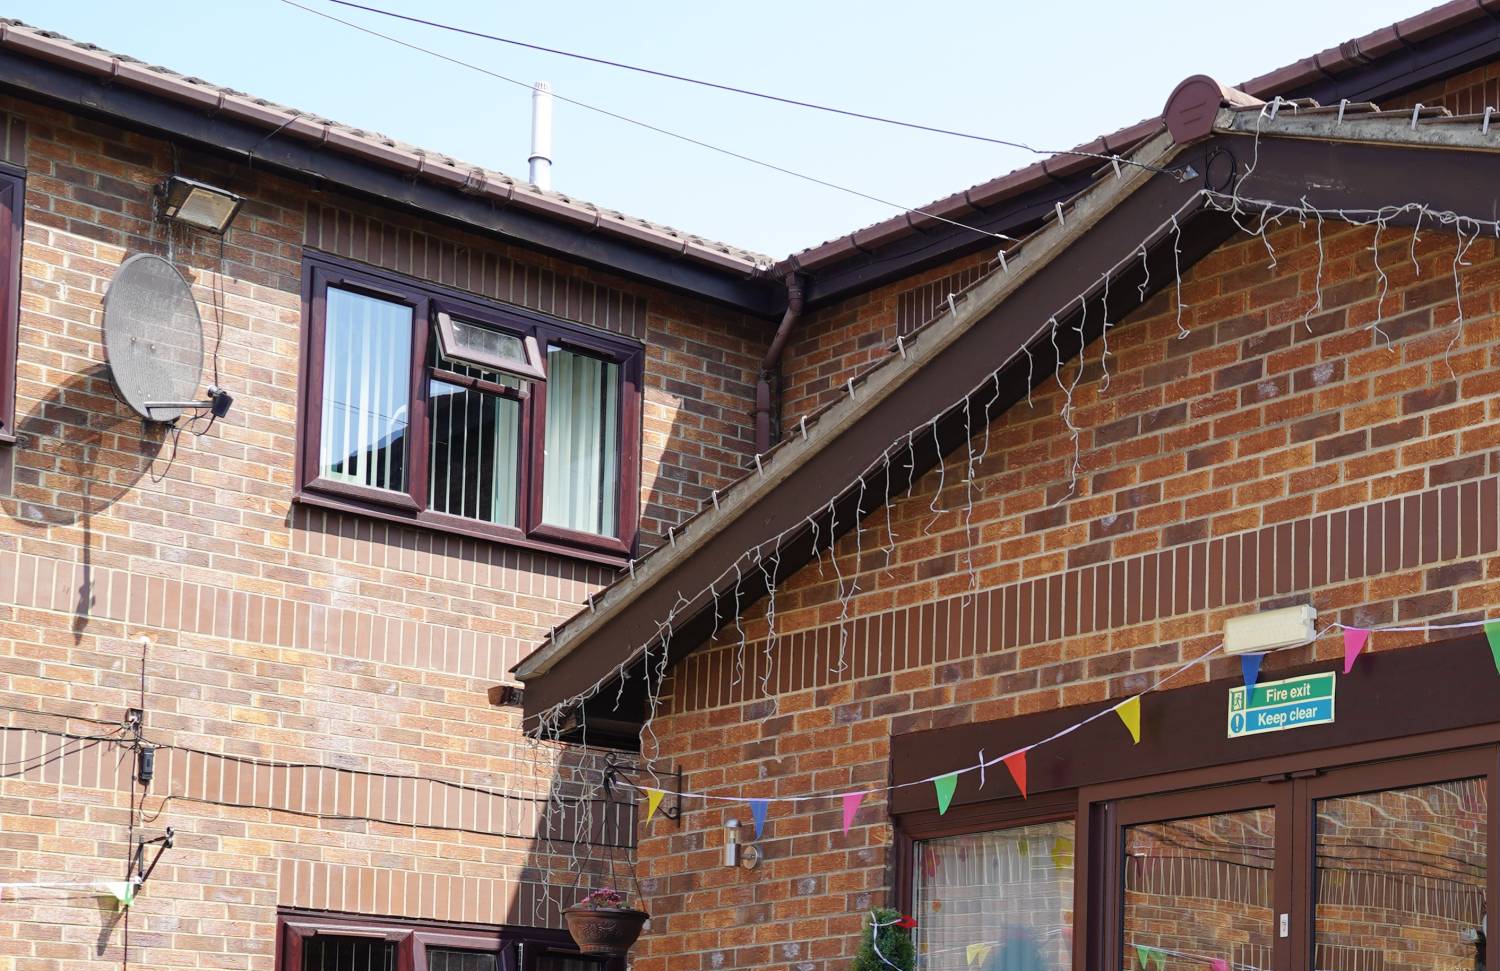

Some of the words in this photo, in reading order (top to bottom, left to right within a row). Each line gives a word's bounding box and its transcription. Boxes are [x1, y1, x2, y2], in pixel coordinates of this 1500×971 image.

[1266, 688, 1287, 703] Fire
[1290, 683, 1311, 698] exit
[1258, 711, 1287, 727] Keep
[1289, 706, 1318, 721] clear
